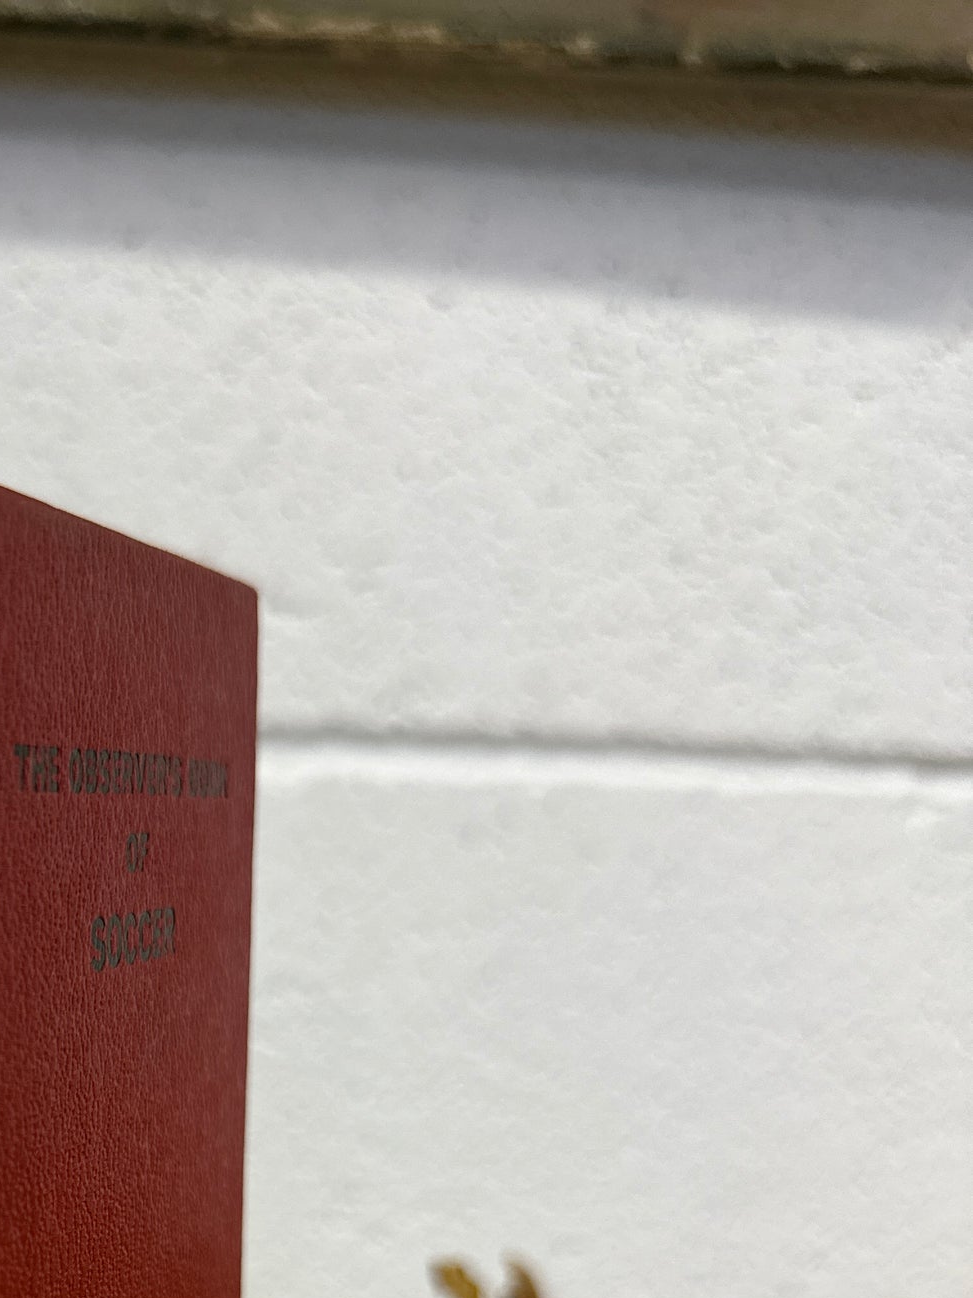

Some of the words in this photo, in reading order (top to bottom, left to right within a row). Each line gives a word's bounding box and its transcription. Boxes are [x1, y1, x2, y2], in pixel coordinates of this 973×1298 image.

[14, 744, 59, 793] THE
[69, 748, 183, 798] OBSERVER'S
[127, 832, 149, 873] OF
[90, 907, 176, 972] SOCCER
